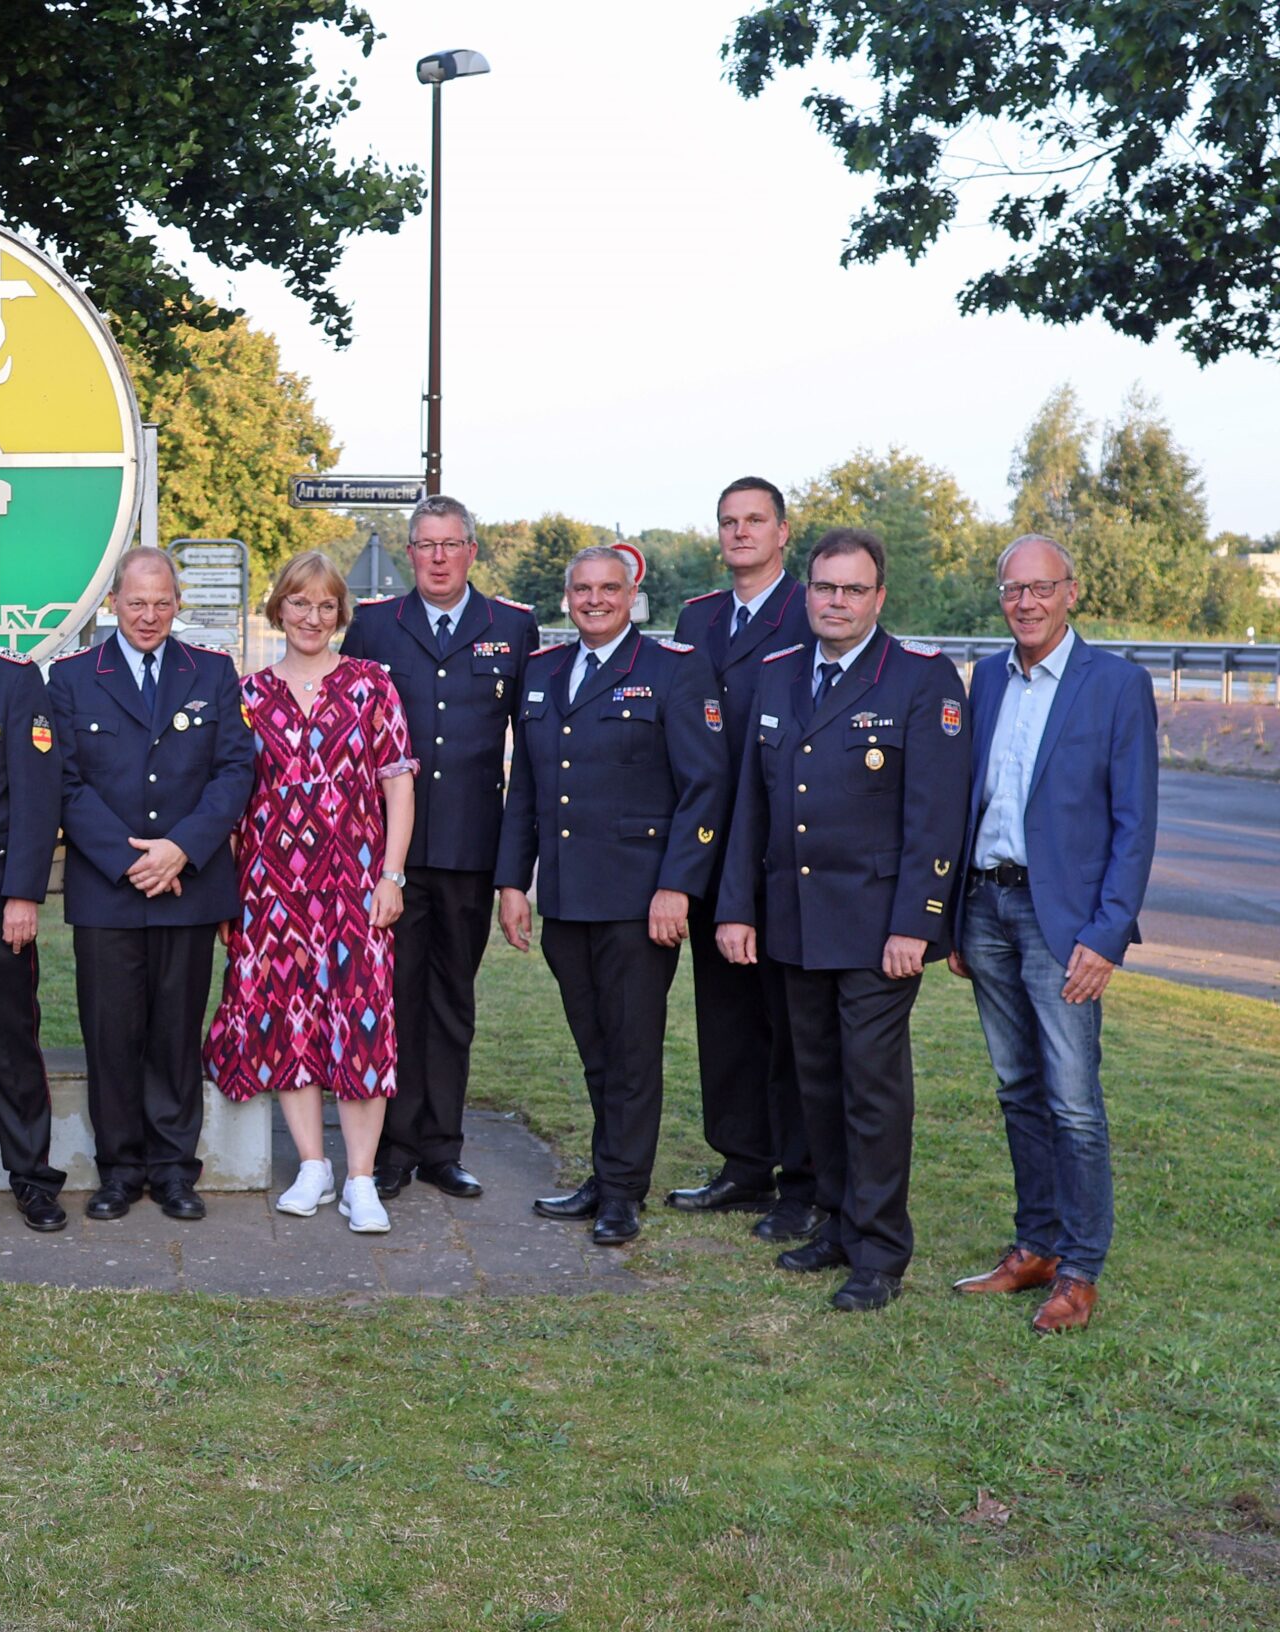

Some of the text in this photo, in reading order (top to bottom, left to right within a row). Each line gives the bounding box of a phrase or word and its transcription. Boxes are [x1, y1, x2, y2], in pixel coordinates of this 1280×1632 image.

[298, 483, 417, 499] An der Feuerwache
